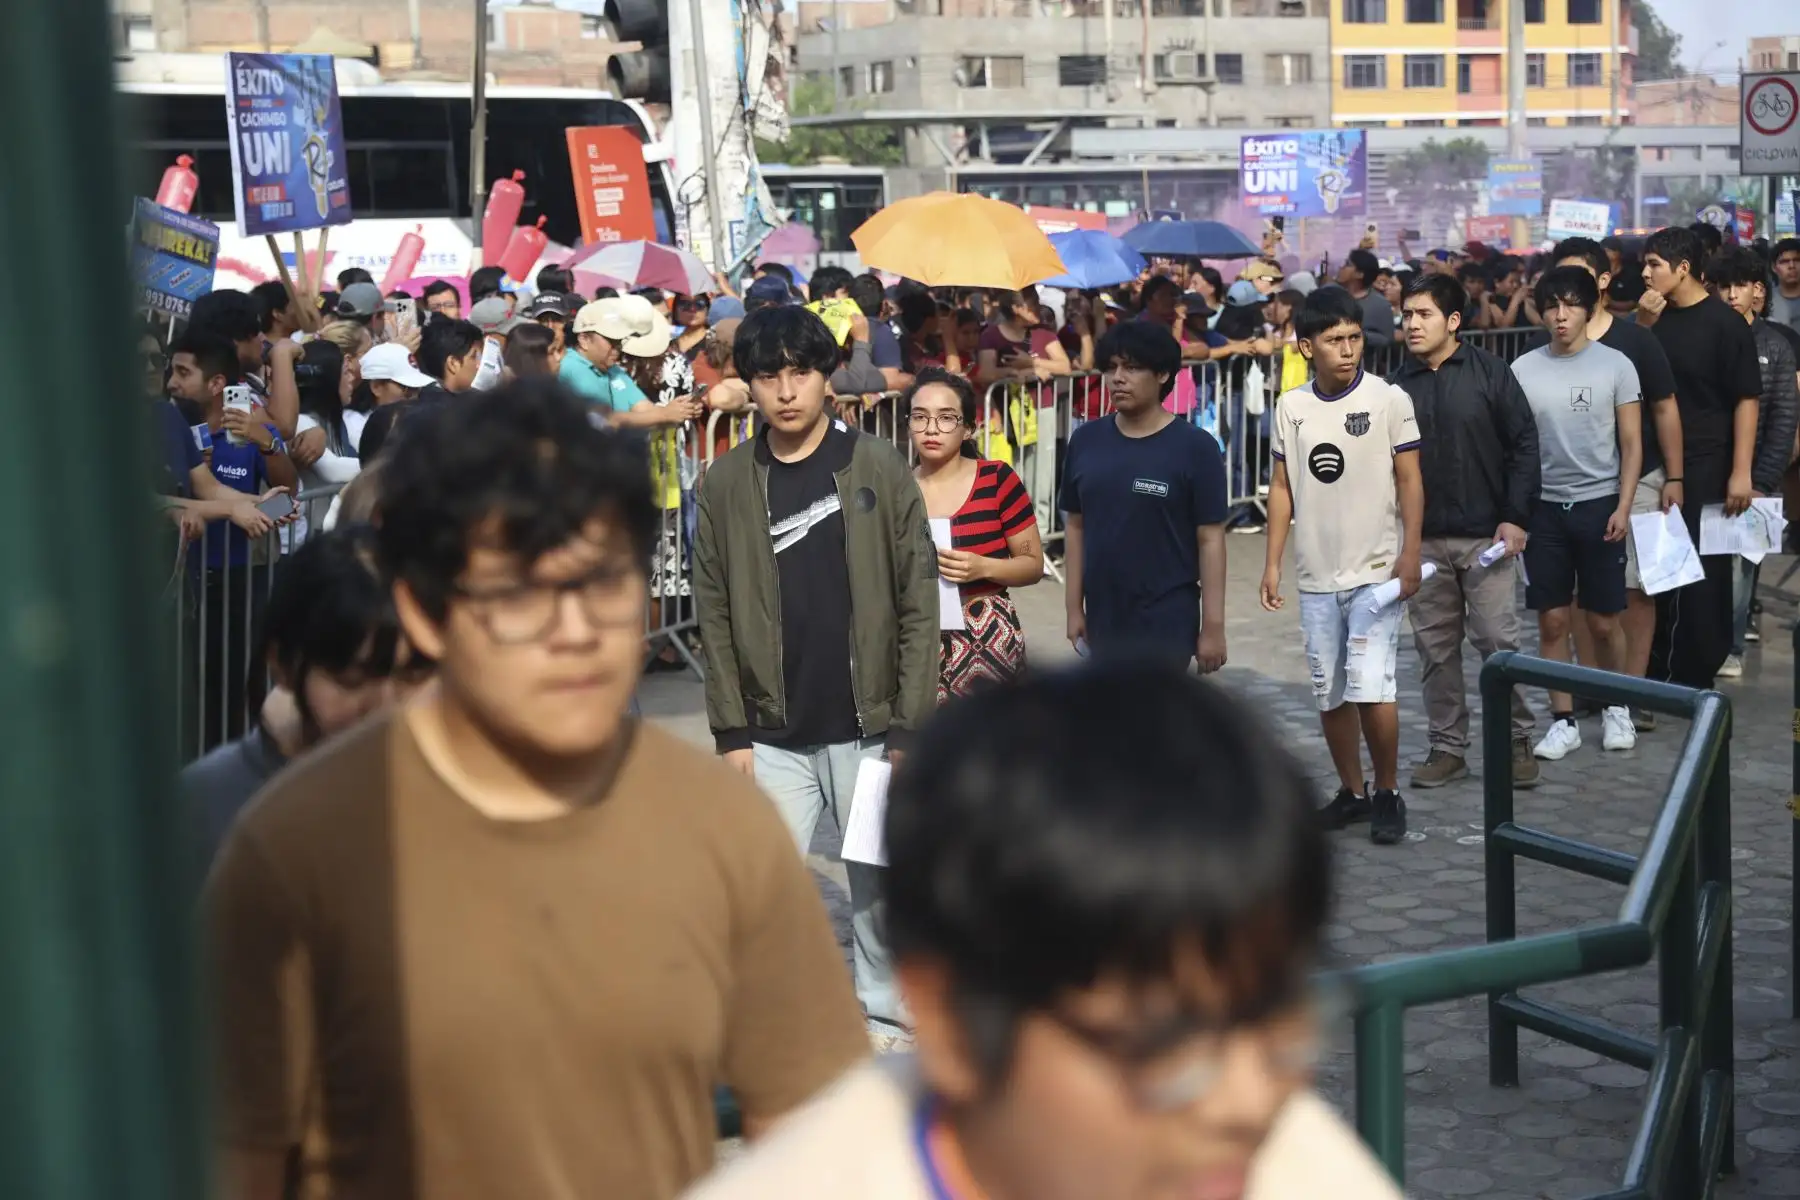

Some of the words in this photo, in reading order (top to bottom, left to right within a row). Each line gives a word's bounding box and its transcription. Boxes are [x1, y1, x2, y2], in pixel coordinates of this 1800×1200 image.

[236, 61, 284, 95] ÉXITO
[240, 112, 287, 127] CACHIMBO
[242, 132, 290, 176] UNI
[1243, 138, 1298, 155] ÉXITO
[1244, 169, 1298, 193] UNI
[217, 464, 247, 475] Aula20
